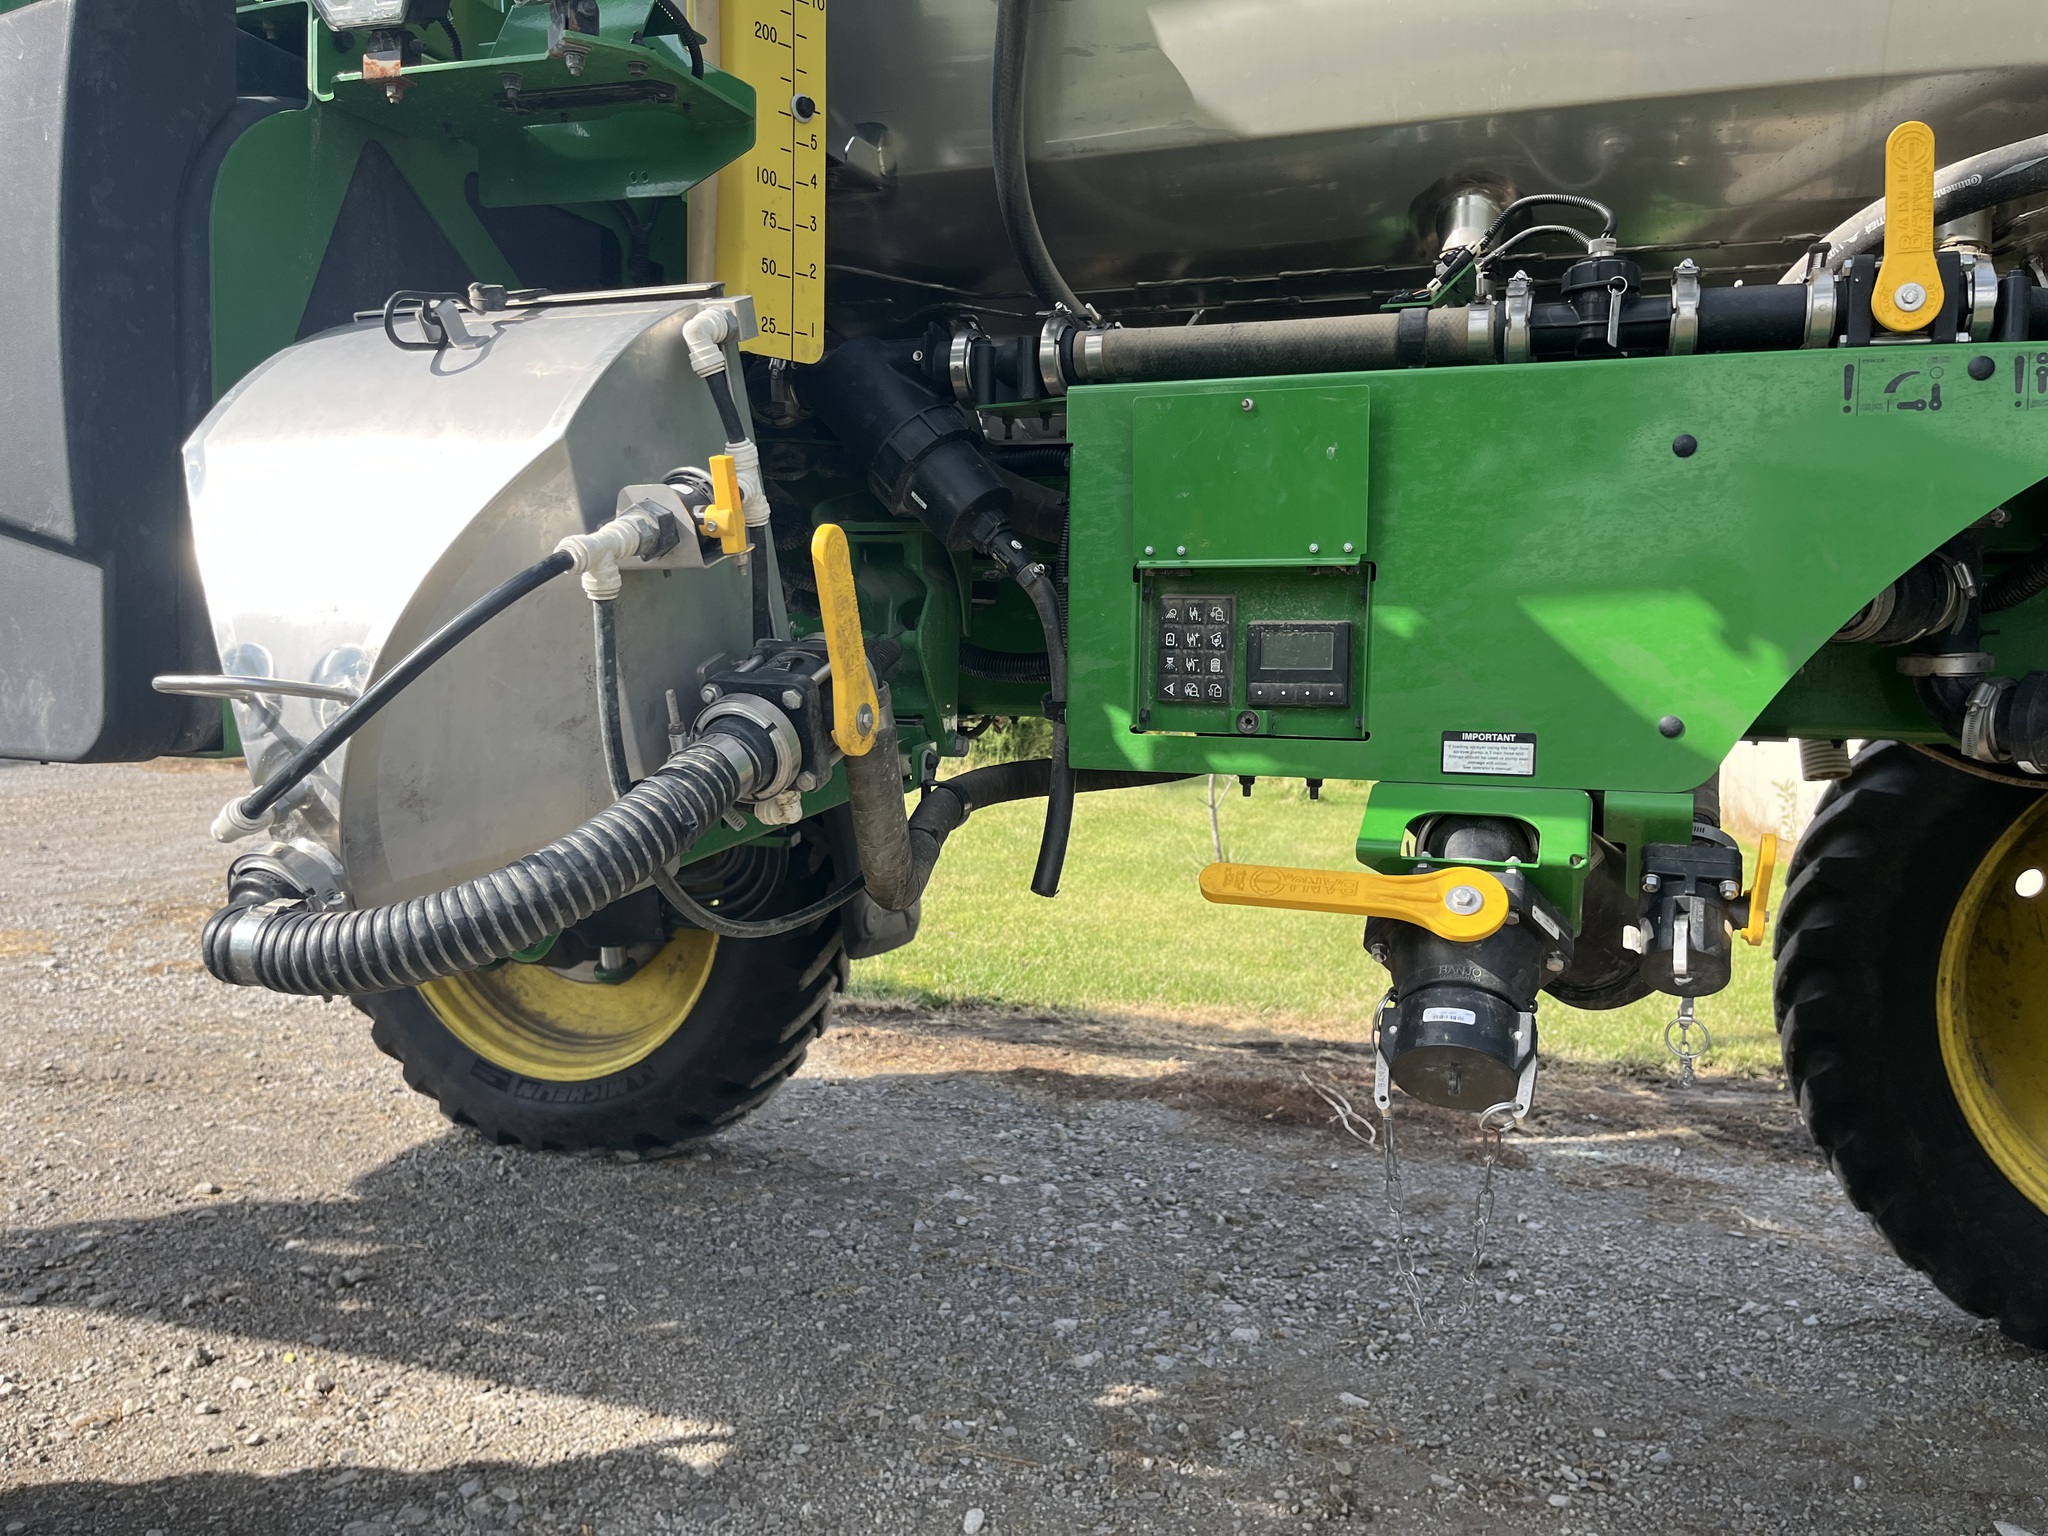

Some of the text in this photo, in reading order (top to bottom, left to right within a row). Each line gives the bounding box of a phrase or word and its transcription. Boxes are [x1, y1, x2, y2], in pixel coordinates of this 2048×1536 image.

[754, 22, 778, 43] 200
[811, 135, 817, 150] 5
[756, 166, 777, 187] 100
[810, 174, 817, 189] 4
[761, 210, 777, 229] 75
[810, 216, 817, 232] 3
[761, 258, 777, 276] 50
[809, 264, 817, 279] 2
[761, 317, 777, 334] 25
[811, 323, 815, 338] 1
[1462, 732, 1516, 742] IMPORTANT
[1439, 964, 1481, 978] BANJO
[1378, 1060, 1386, 1088] BANJO
[516, 1077, 629, 1102] MICHELIN
